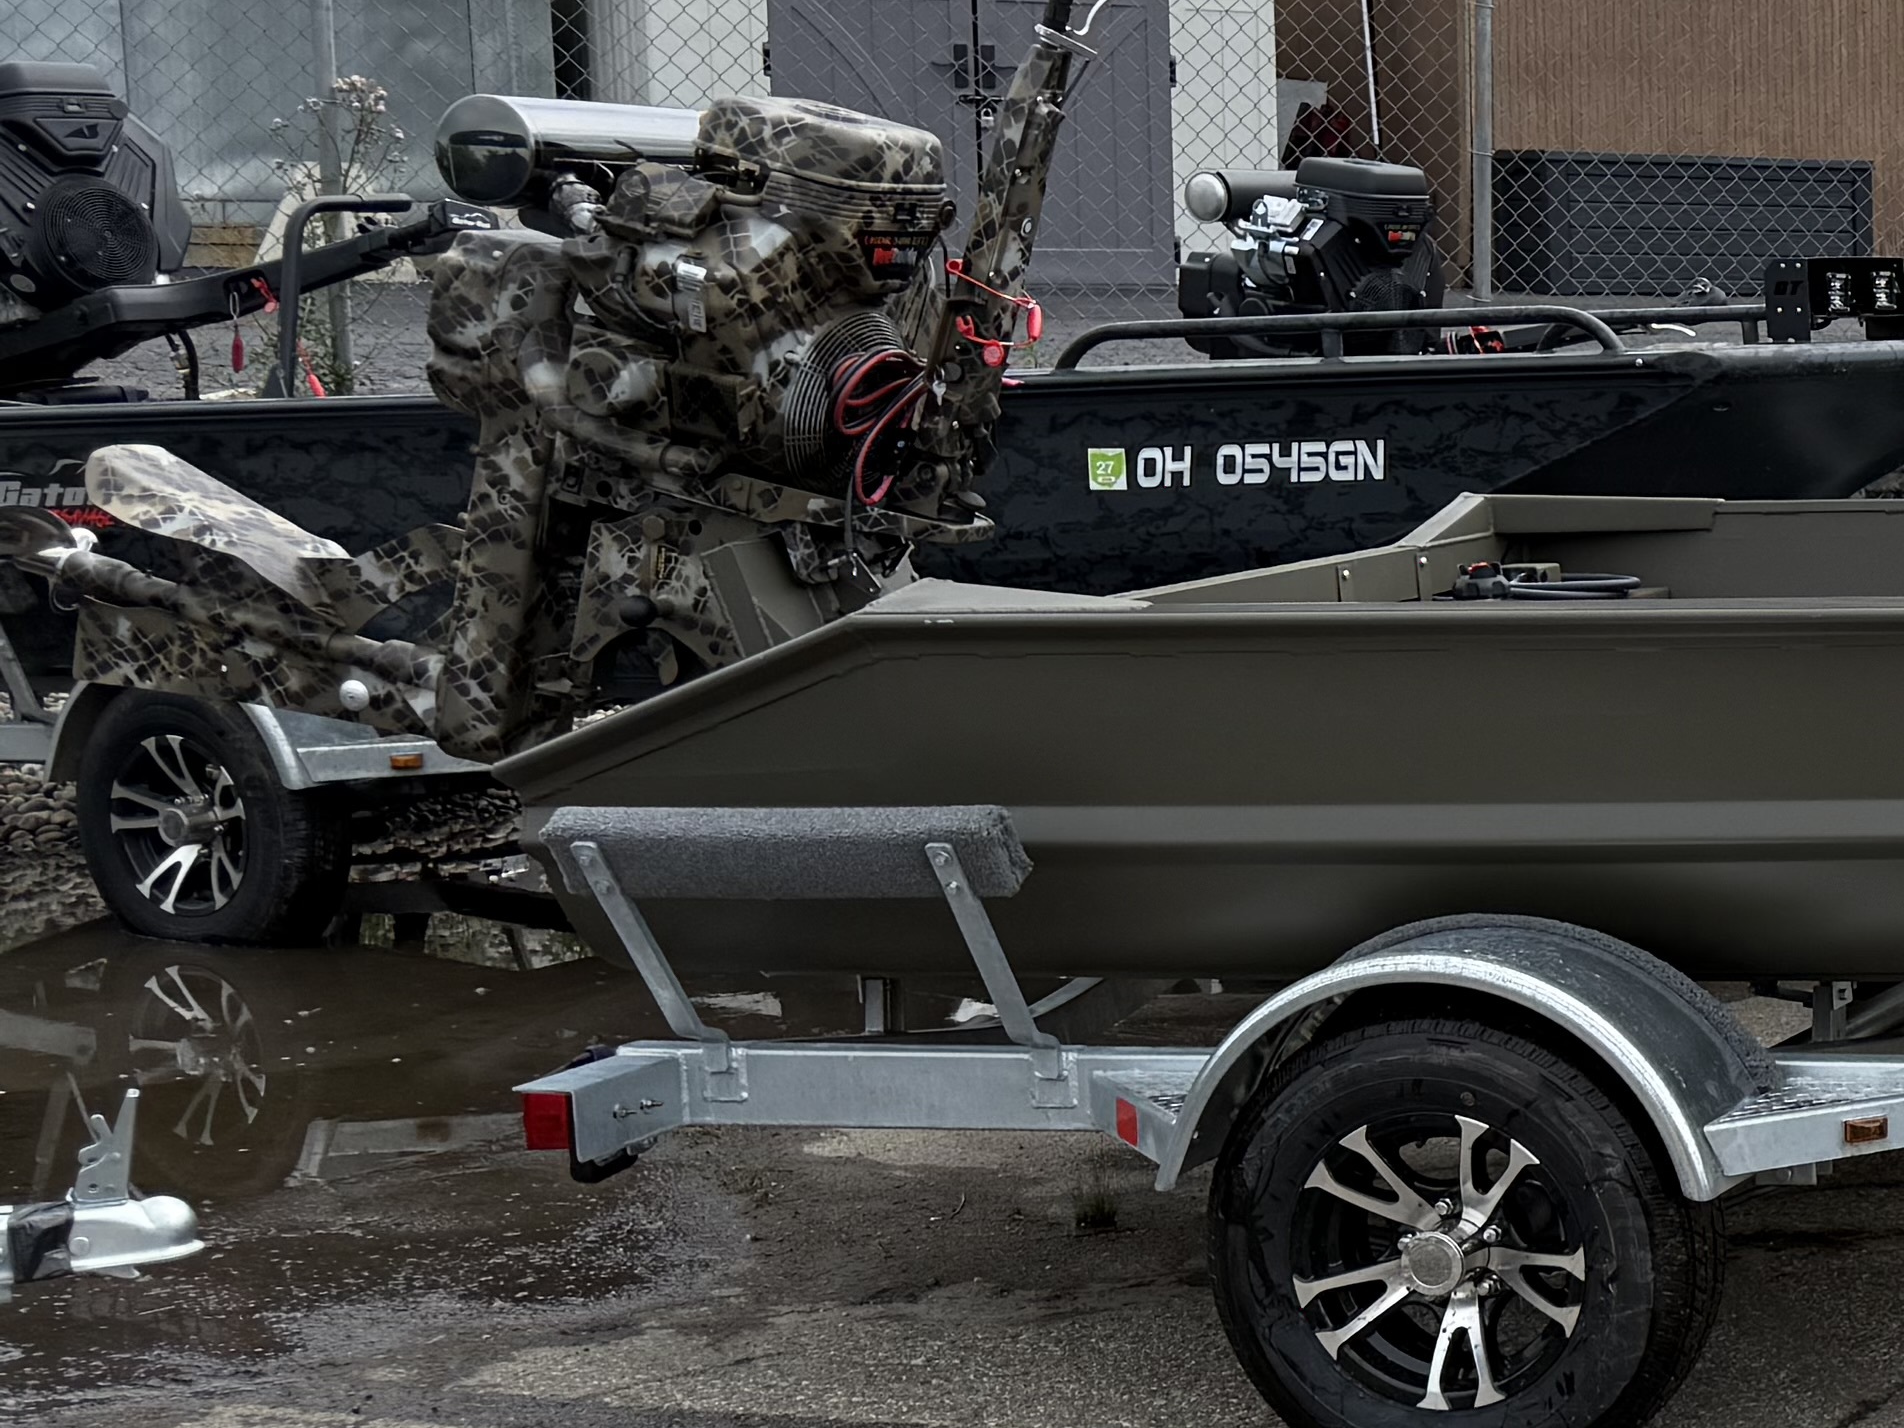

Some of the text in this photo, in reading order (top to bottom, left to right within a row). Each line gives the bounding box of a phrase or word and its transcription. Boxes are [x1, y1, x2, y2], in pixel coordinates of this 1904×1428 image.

[1096, 461, 1115, 475] 27
[1137, 439, 1385, 488] OH 0545GN
[0, 480, 94, 508] Gato
